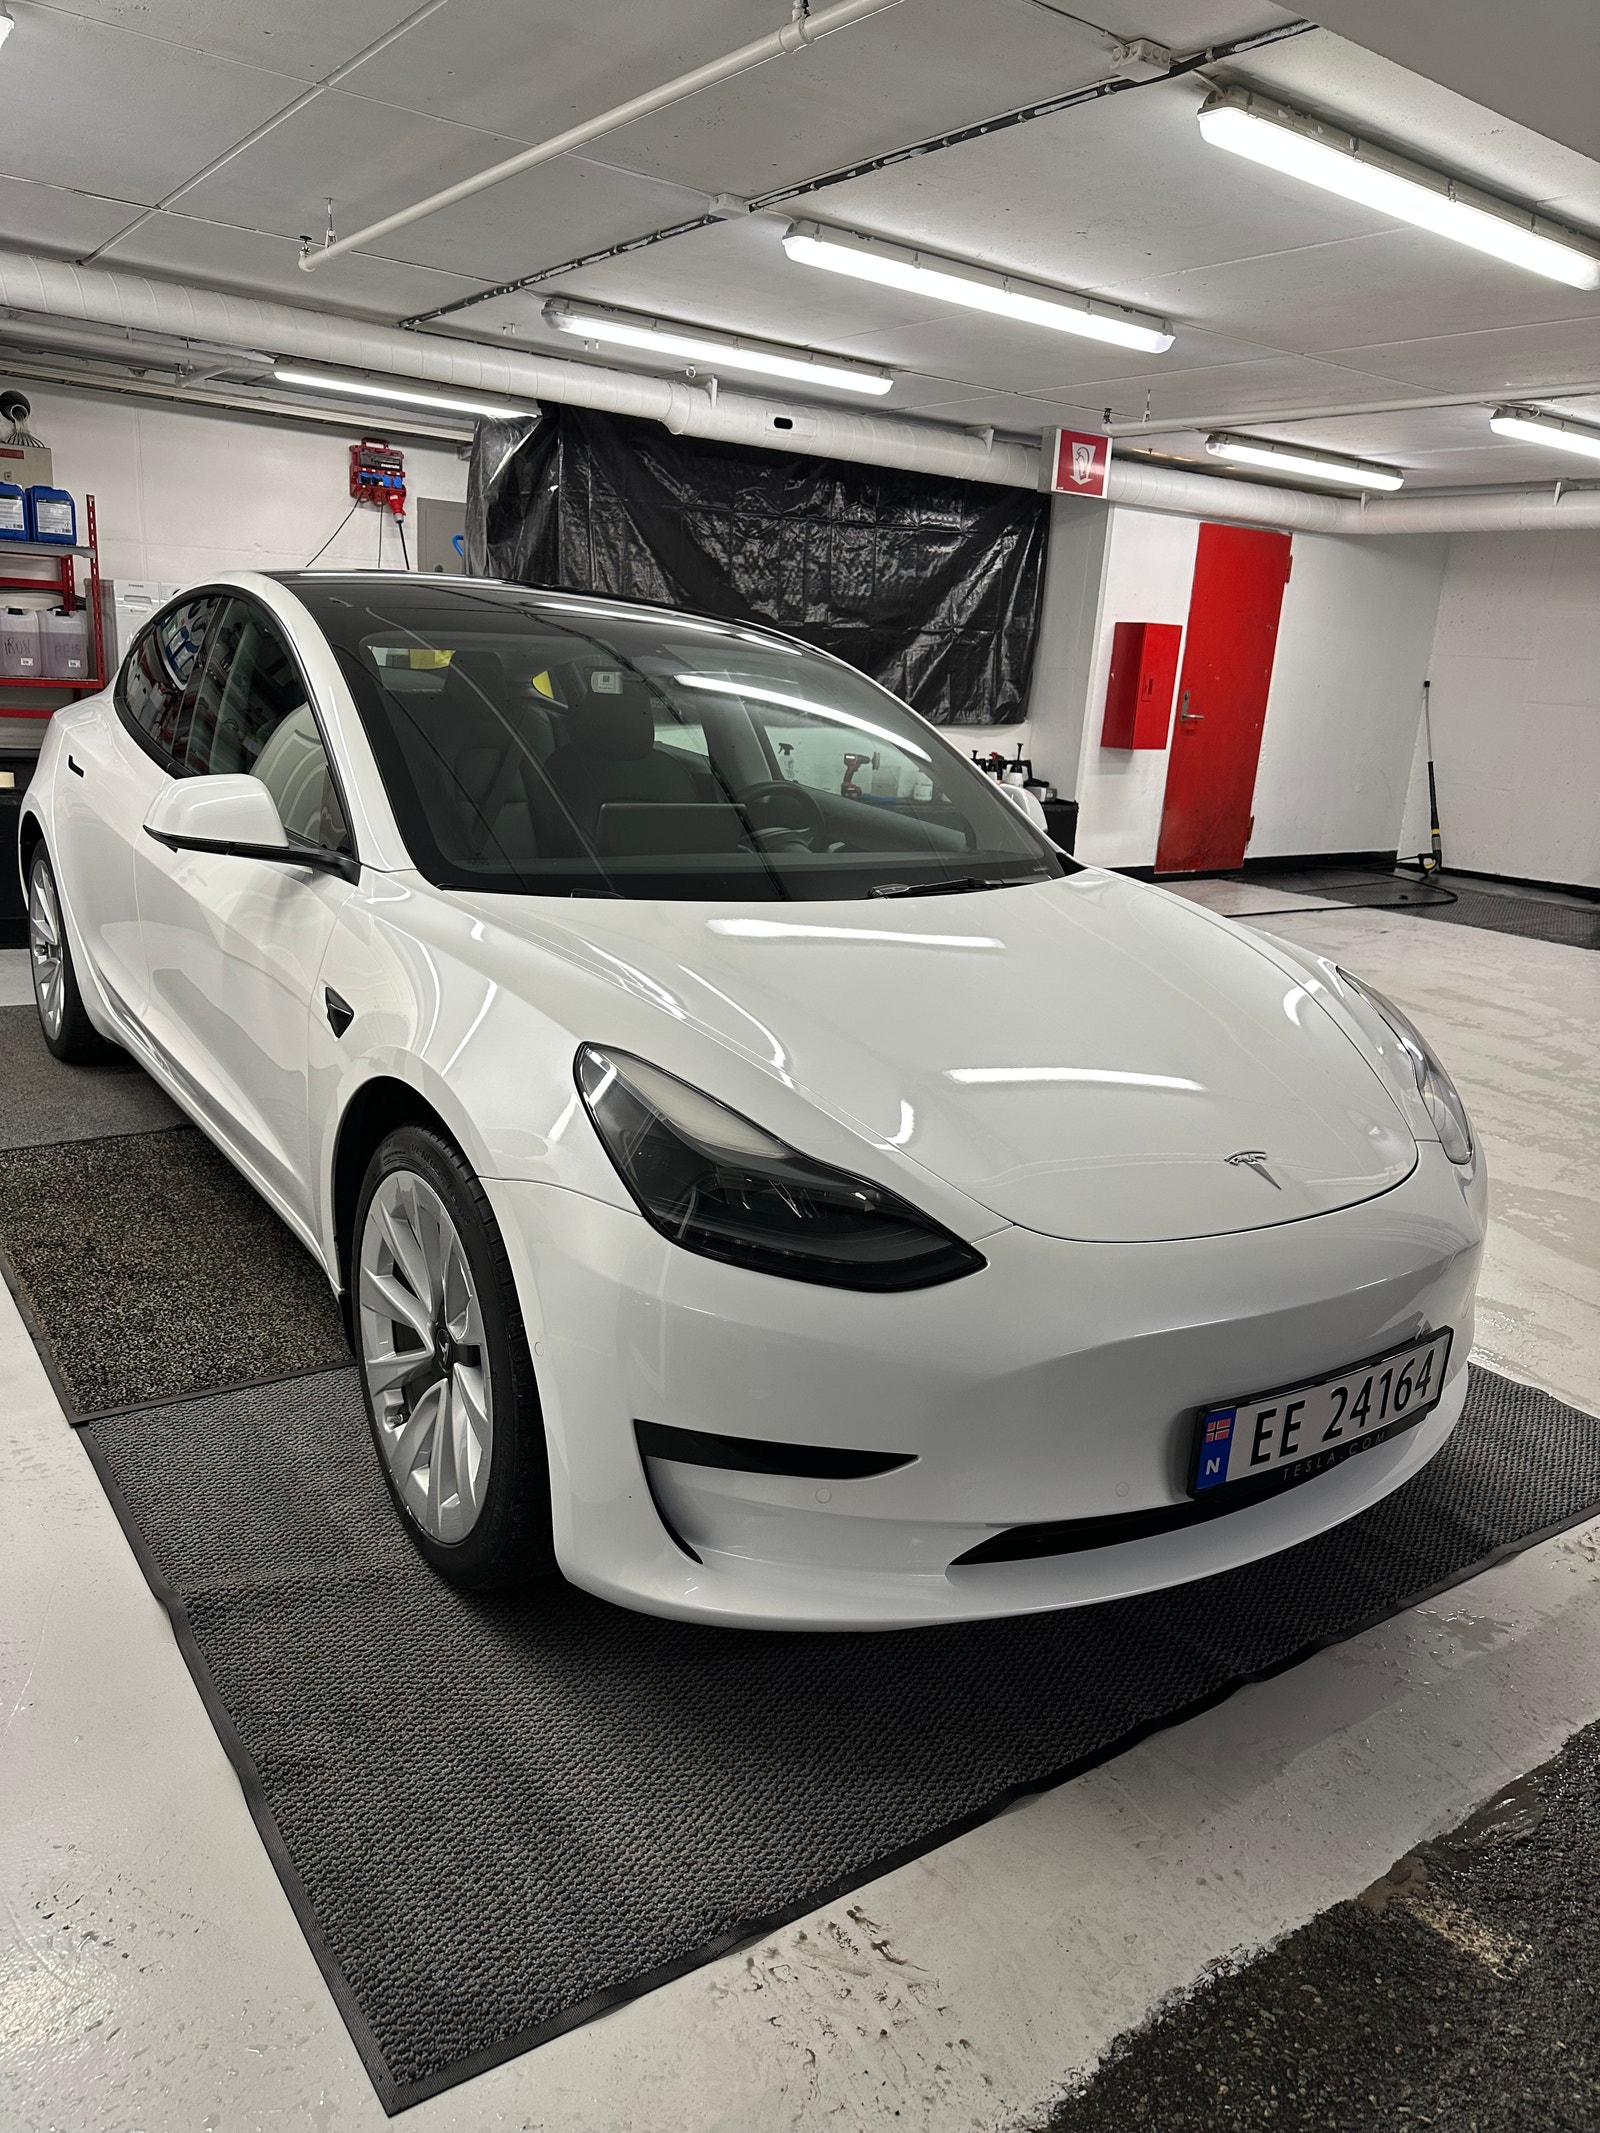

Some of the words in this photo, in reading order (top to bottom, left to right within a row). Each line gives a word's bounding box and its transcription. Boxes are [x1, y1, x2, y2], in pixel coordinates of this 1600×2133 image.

[1250, 1400, 1305, 1466] EE
[1322, 1348, 1435, 1443] 24164
[1205, 1457, 1221, 1476] N
[1283, 1431, 1386, 1481] TESLA.COM
